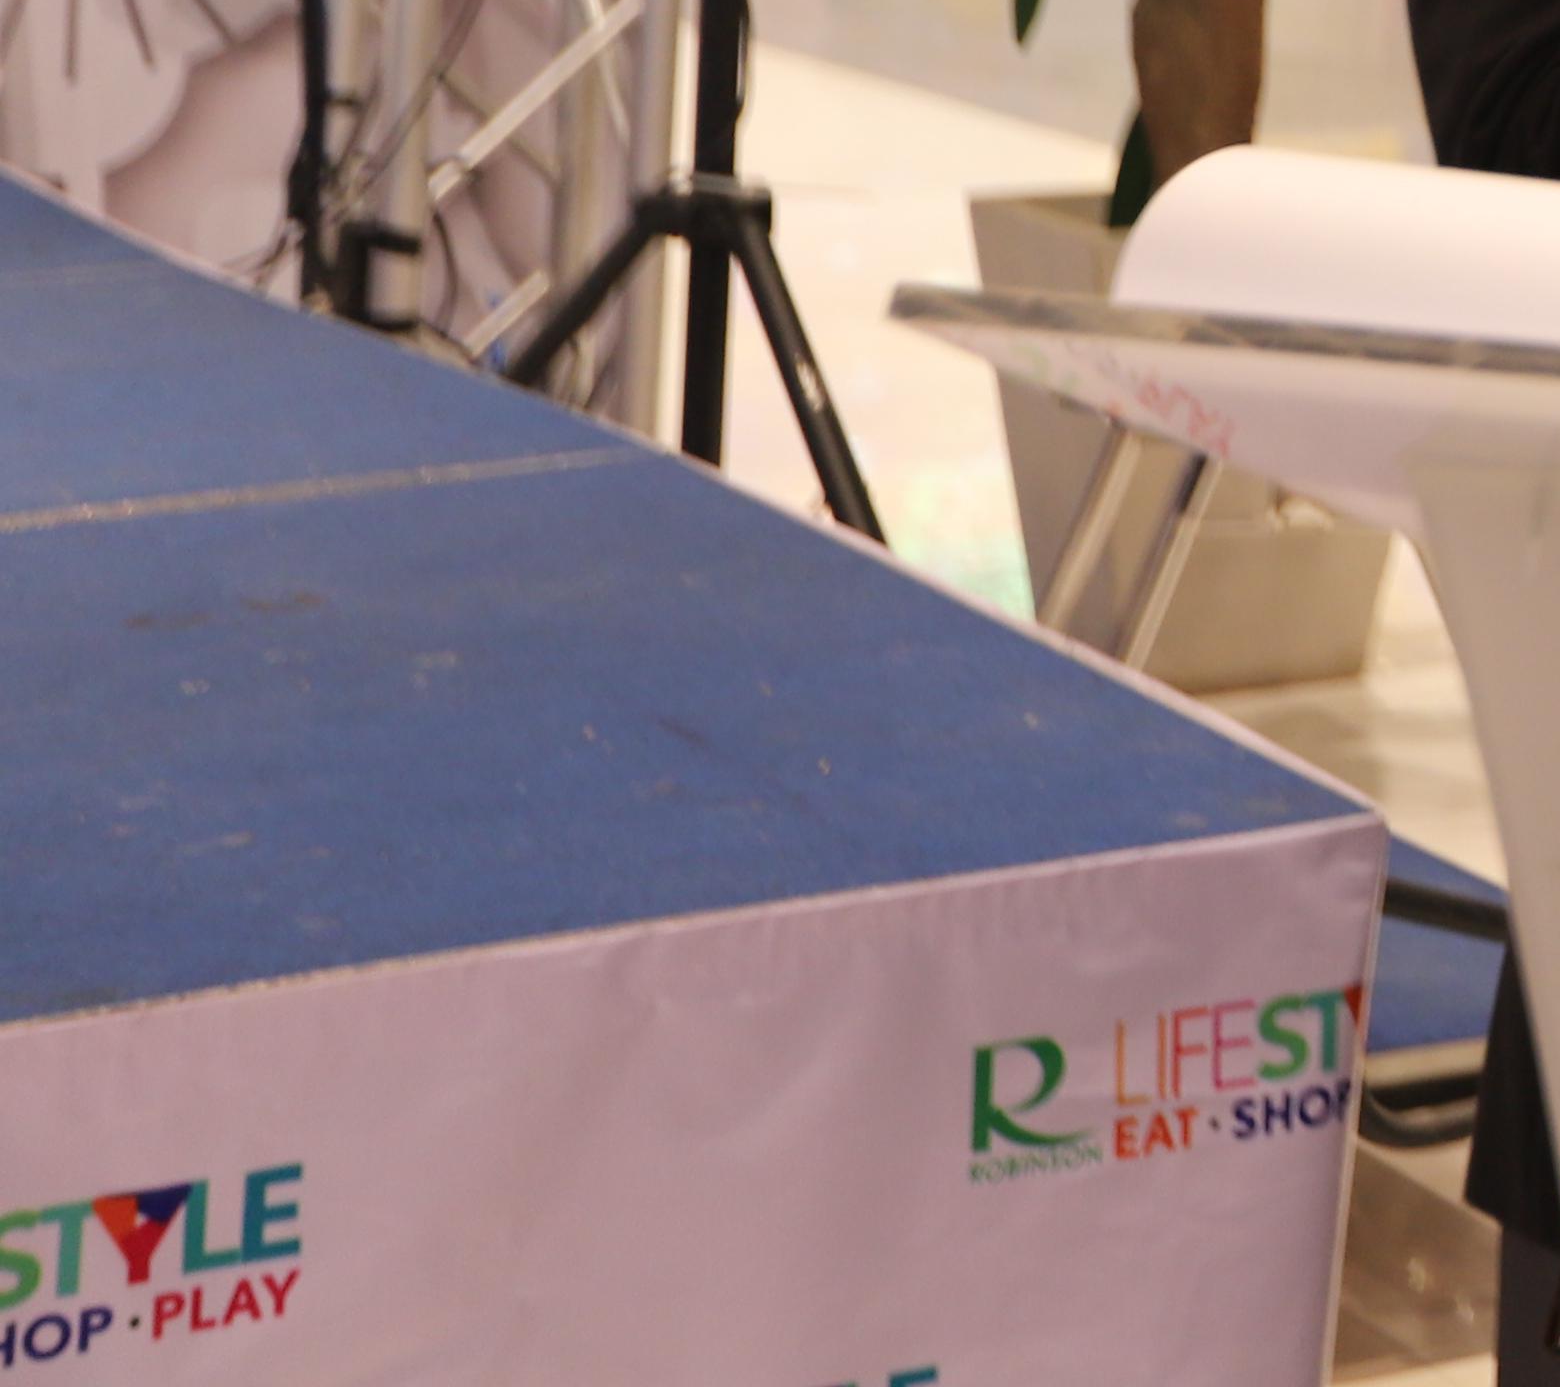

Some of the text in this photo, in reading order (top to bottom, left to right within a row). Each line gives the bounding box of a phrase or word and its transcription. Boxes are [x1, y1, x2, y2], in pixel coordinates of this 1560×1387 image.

[1113, 984, 1364, 1108] LIFEST
[1113, 1107, 1201, 1161] EAT
[152, 1268, 300, 1341] PLAY
